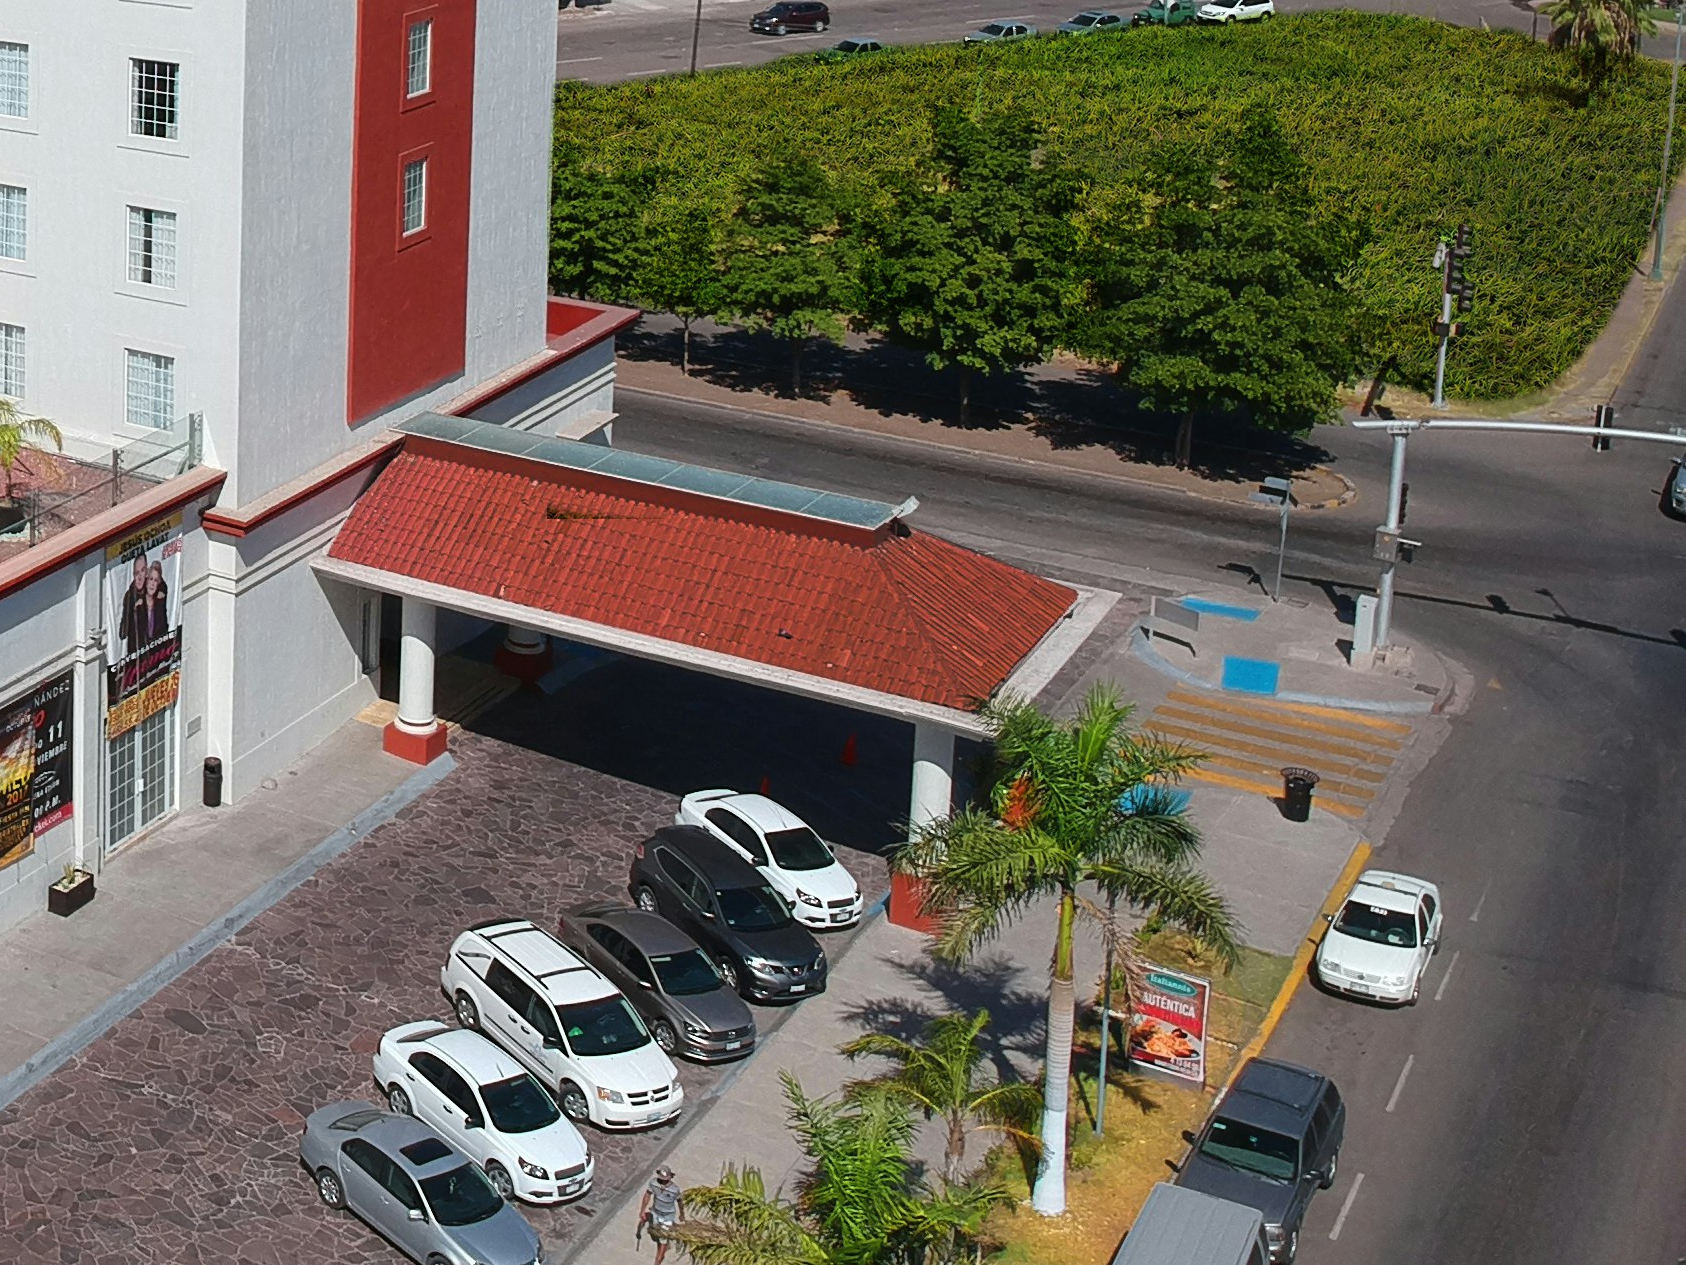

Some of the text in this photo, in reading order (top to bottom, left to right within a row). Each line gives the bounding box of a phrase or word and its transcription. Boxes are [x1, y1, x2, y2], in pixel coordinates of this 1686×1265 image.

[34, 681, 70, 707] NÁNDEZ
[48, 720, 63, 743] 11
[36, 740, 68, 766] VIEMBRE
[1143, 992, 1195, 1018] AUTÉNTICA
